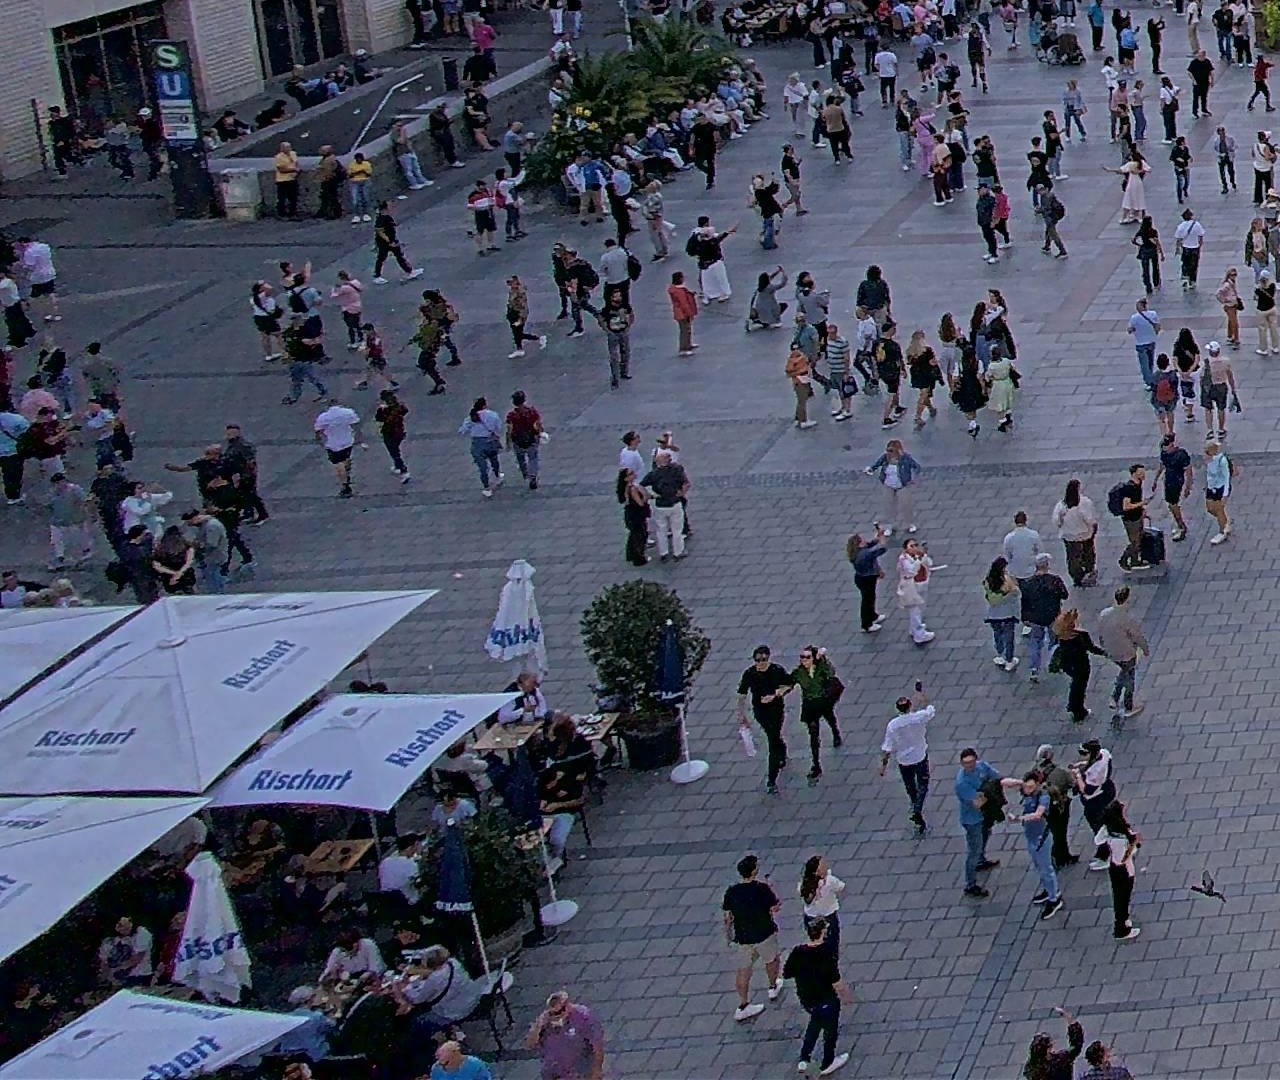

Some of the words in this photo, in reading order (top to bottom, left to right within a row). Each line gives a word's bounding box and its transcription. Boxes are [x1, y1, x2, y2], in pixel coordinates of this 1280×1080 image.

[157, 45, 180, 68] S
[162, 74, 182, 96] U
[221, 639, 296, 690] Rischart
[35, 727, 138, 748] Rischart
[384, 709, 466, 768] Rischart
[247, 768, 353, 792] Rischart
